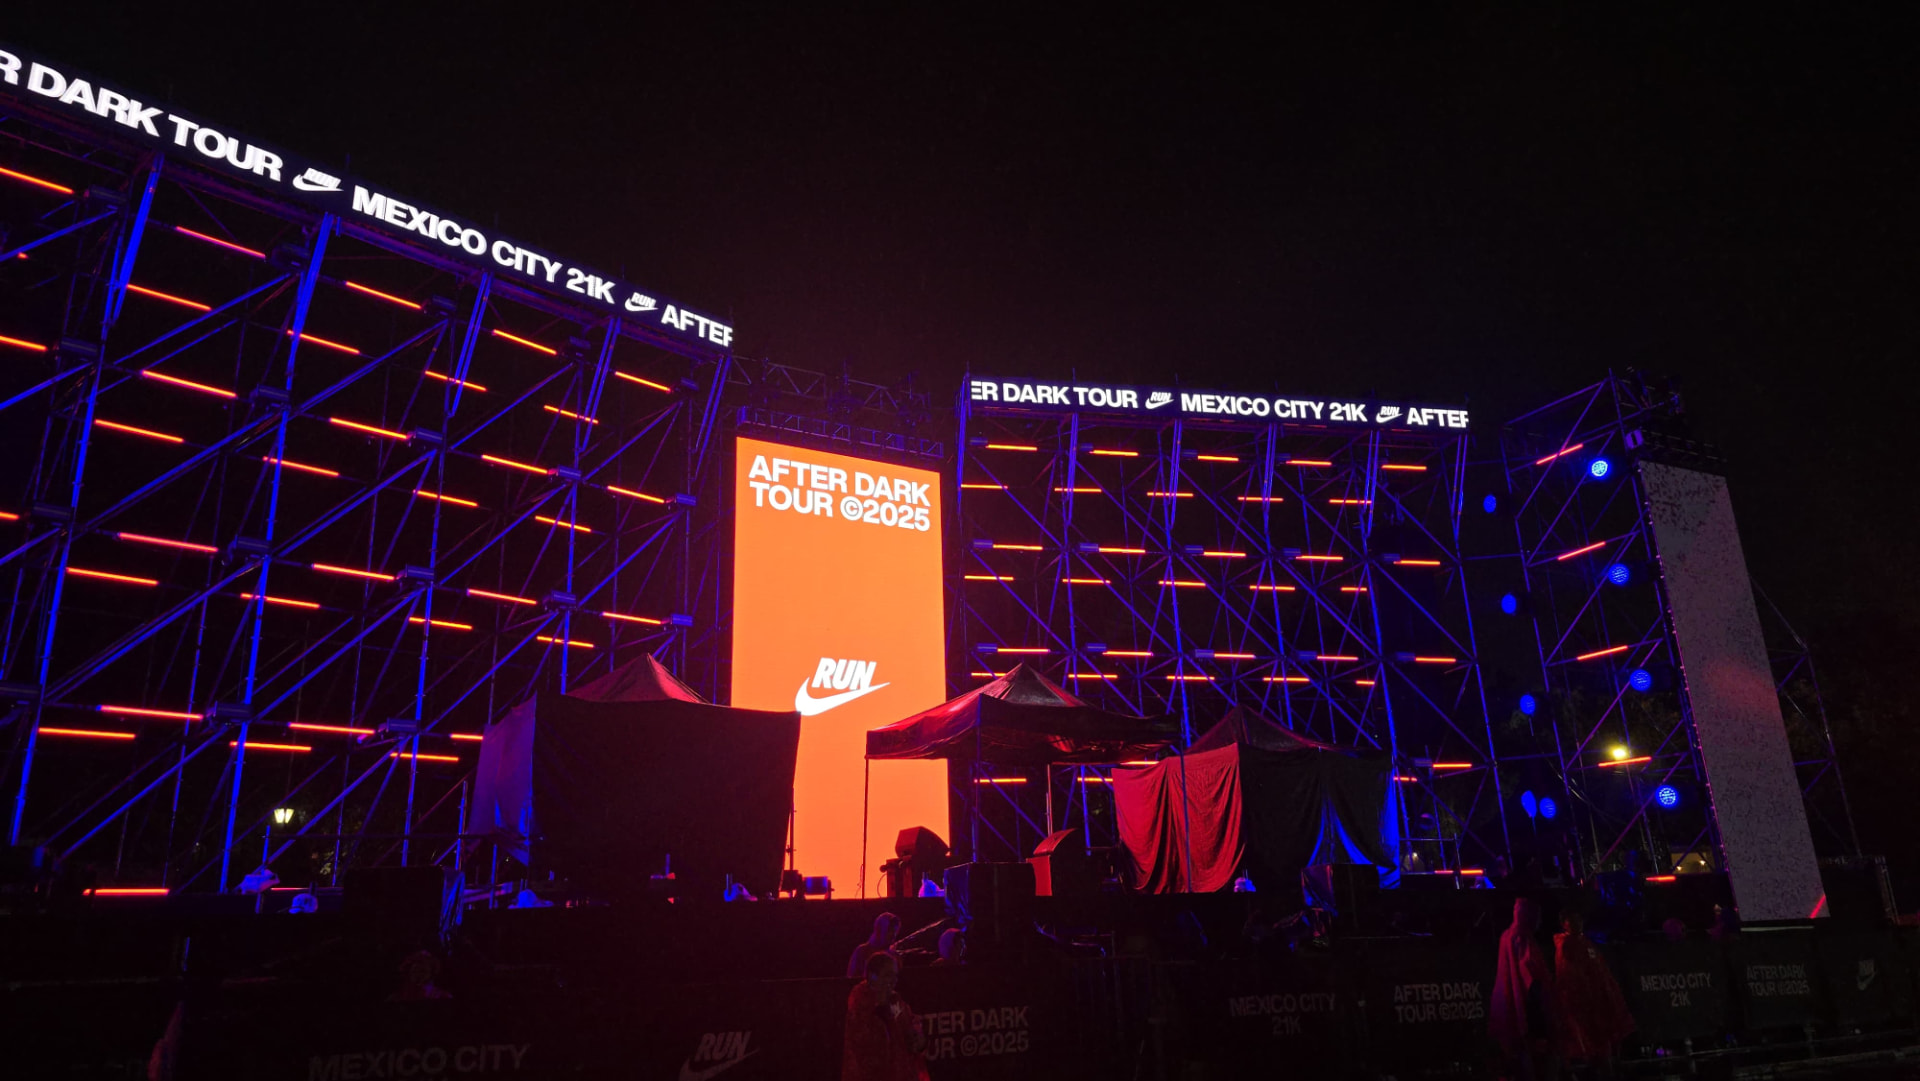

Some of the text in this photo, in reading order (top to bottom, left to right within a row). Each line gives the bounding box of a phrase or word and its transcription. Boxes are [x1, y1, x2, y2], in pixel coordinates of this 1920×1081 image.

[27, 61, 164, 137] DARK
[168, 113, 284, 182] TOUR
[303, 167, 342, 189] RUN
[352, 184, 615, 305] MEXICO CITY 21K
[631, 292, 656, 309] RUN
[1002, 382, 1070, 405] DARK
[1072, 386, 1139, 409] TOUR
[1150, 391, 1172, 402] RUN
[1180, 392, 1368, 423] MEXICO CITY 21K
[1380, 405, 1400, 416] RUN
[748, 455, 931, 507] AFTER DARK
[749, 480, 834, 518] TOUR
[811, 657, 877, 690] RUN
[1641, 972, 1712, 993] MEXICO CITY
[1779, 963, 1807, 978] DARK
[1394, 982, 1482, 1003] AFTER DARK
[1670, 991, 1693, 1007] 21K
[1747, 980, 1776, 997] TOUR
[1229, 993, 1336, 1017] MEXICO CITY
[1395, 1003, 1437, 1024] TOUR
[920, 1005, 1029, 1035] TER DARK
[1272, 1015, 1302, 1036] 21K
[695, 1030, 752, 1063] RUN
[922, 1030, 1029, 1061] UR ©2025
[308, 1043, 531, 1081] MEXICO CITY
